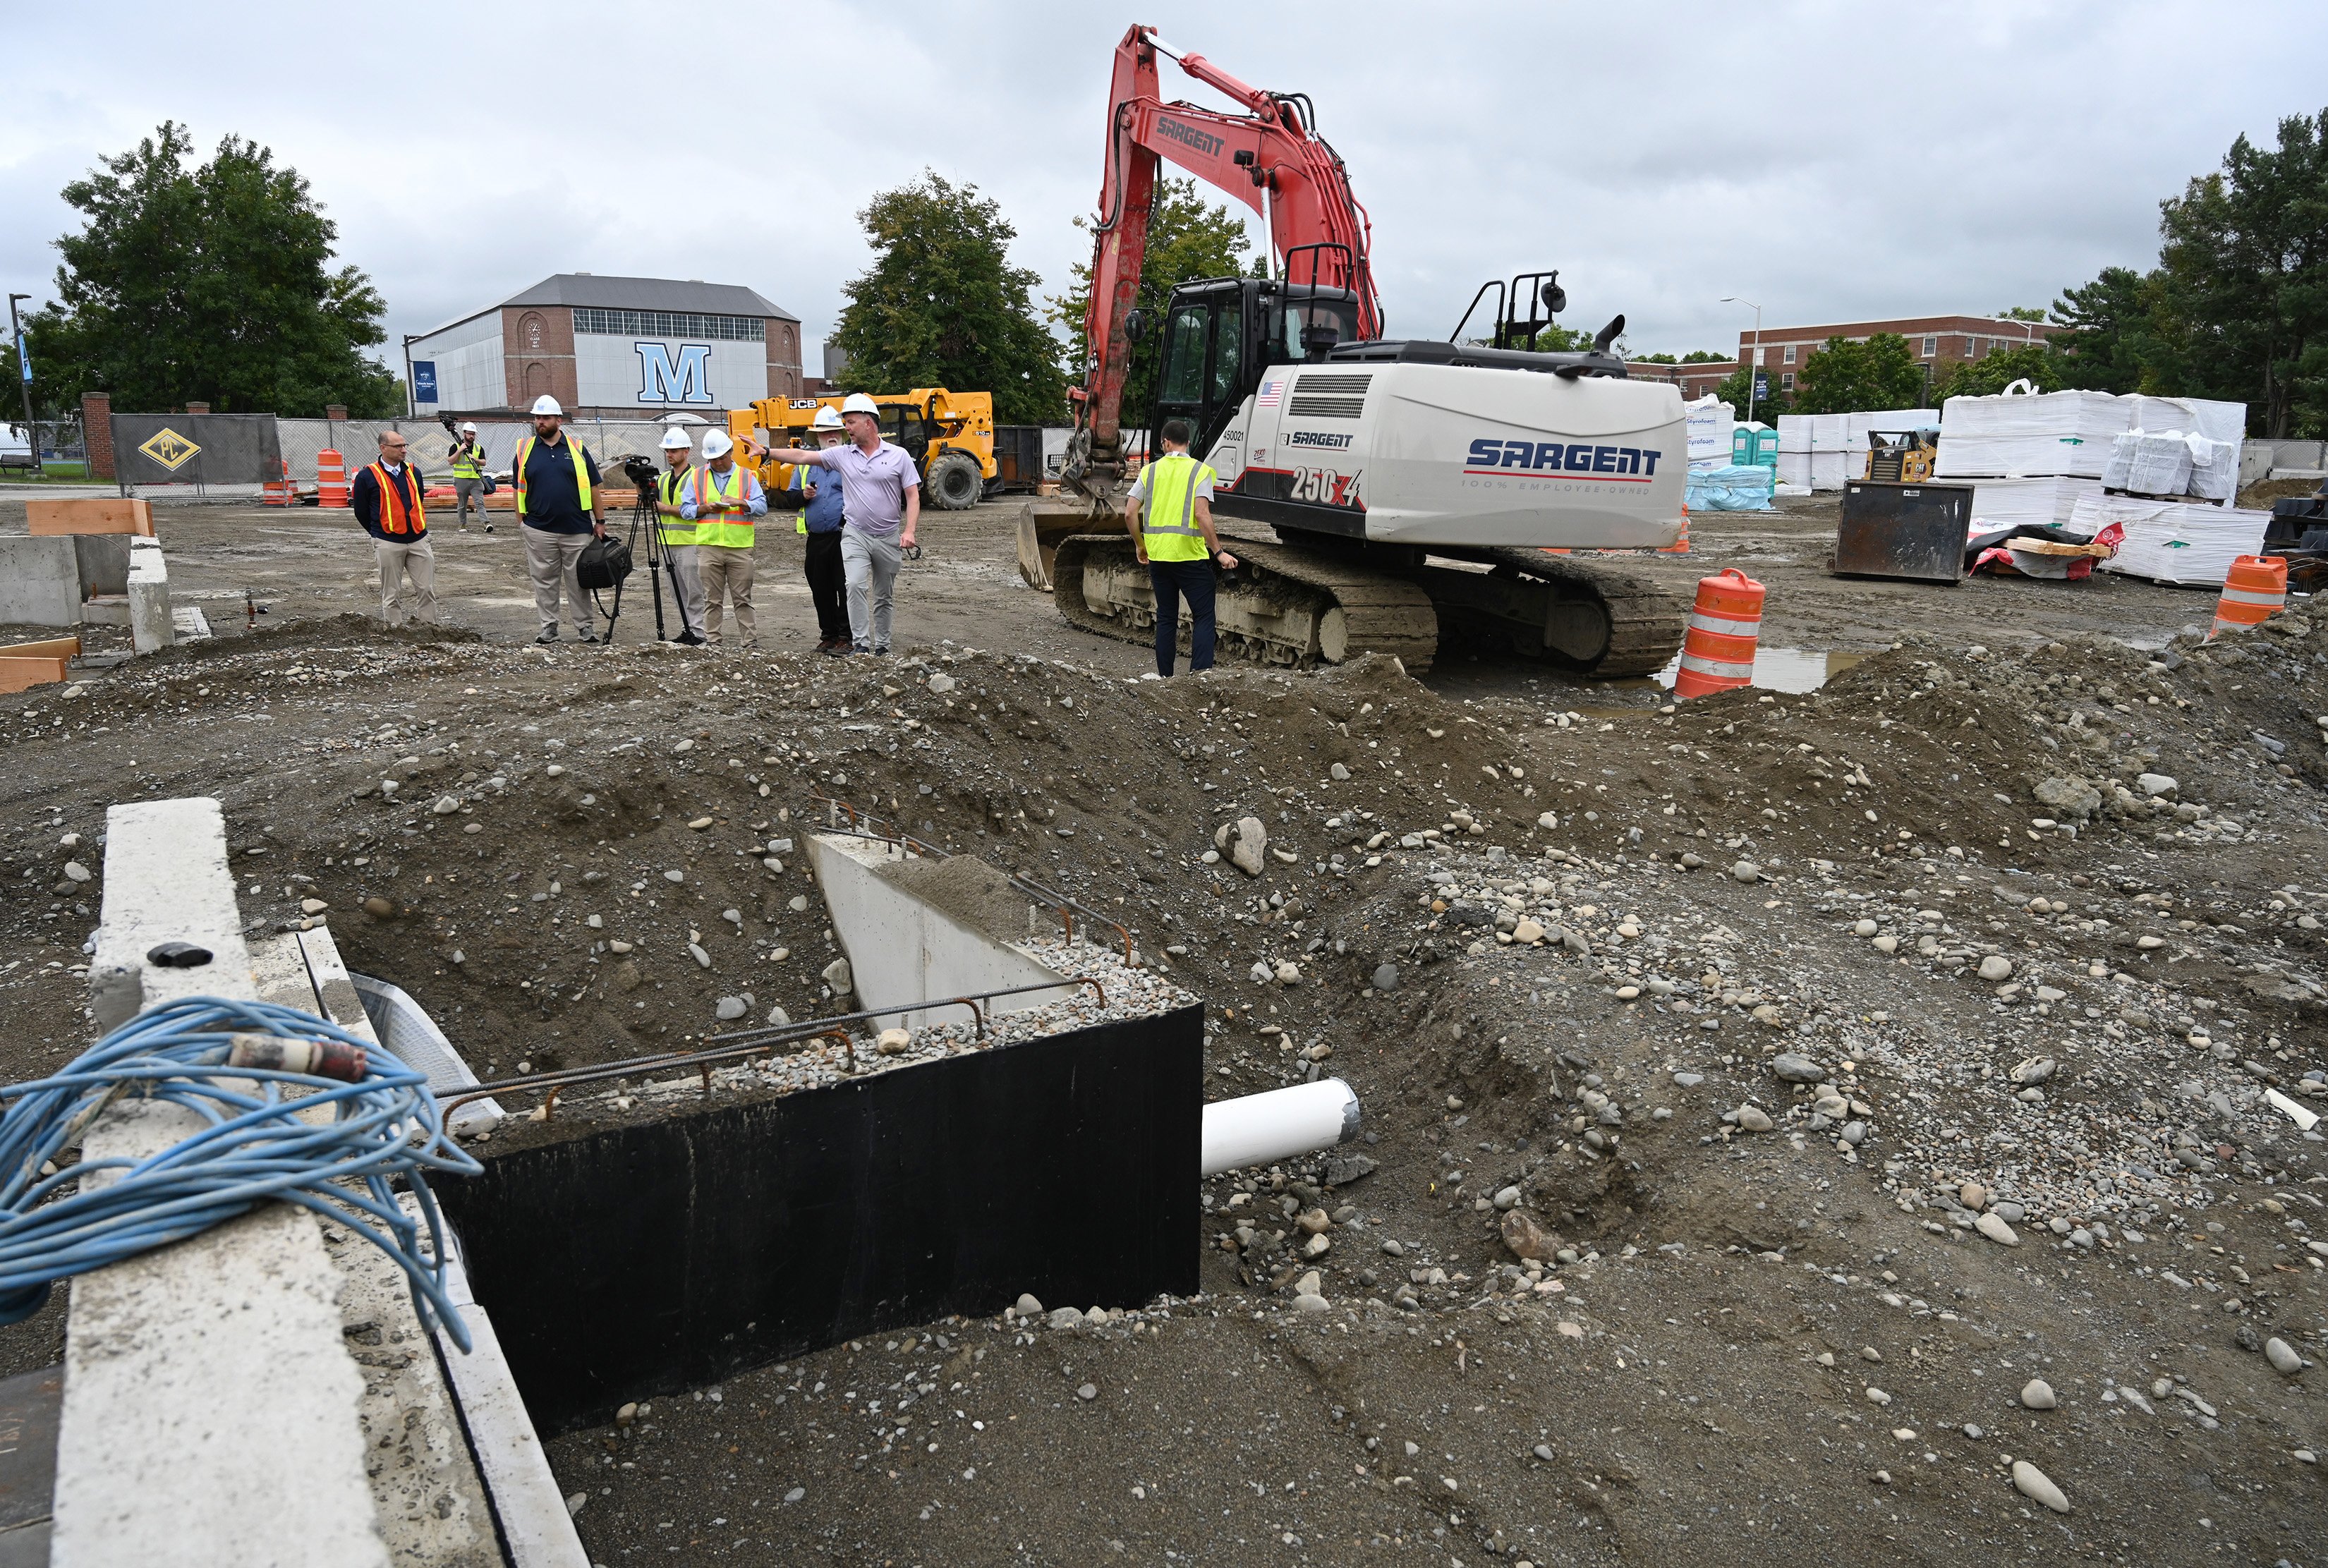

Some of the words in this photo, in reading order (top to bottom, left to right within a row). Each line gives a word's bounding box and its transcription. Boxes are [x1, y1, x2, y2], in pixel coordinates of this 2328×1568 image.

[1157, 116, 1225, 157] SARGENT
[634, 341, 713, 404] M
[789, 399, 817, 409] JCB
[1223, 430, 1244, 442] 450021
[1292, 432, 1354, 448] SARGENT
[160, 438, 178, 460] PC
[1466, 439, 1661, 476] SARGENT
[1915, 463, 1925, 473] CAT
[1461, 480, 1508, 489] 100%
